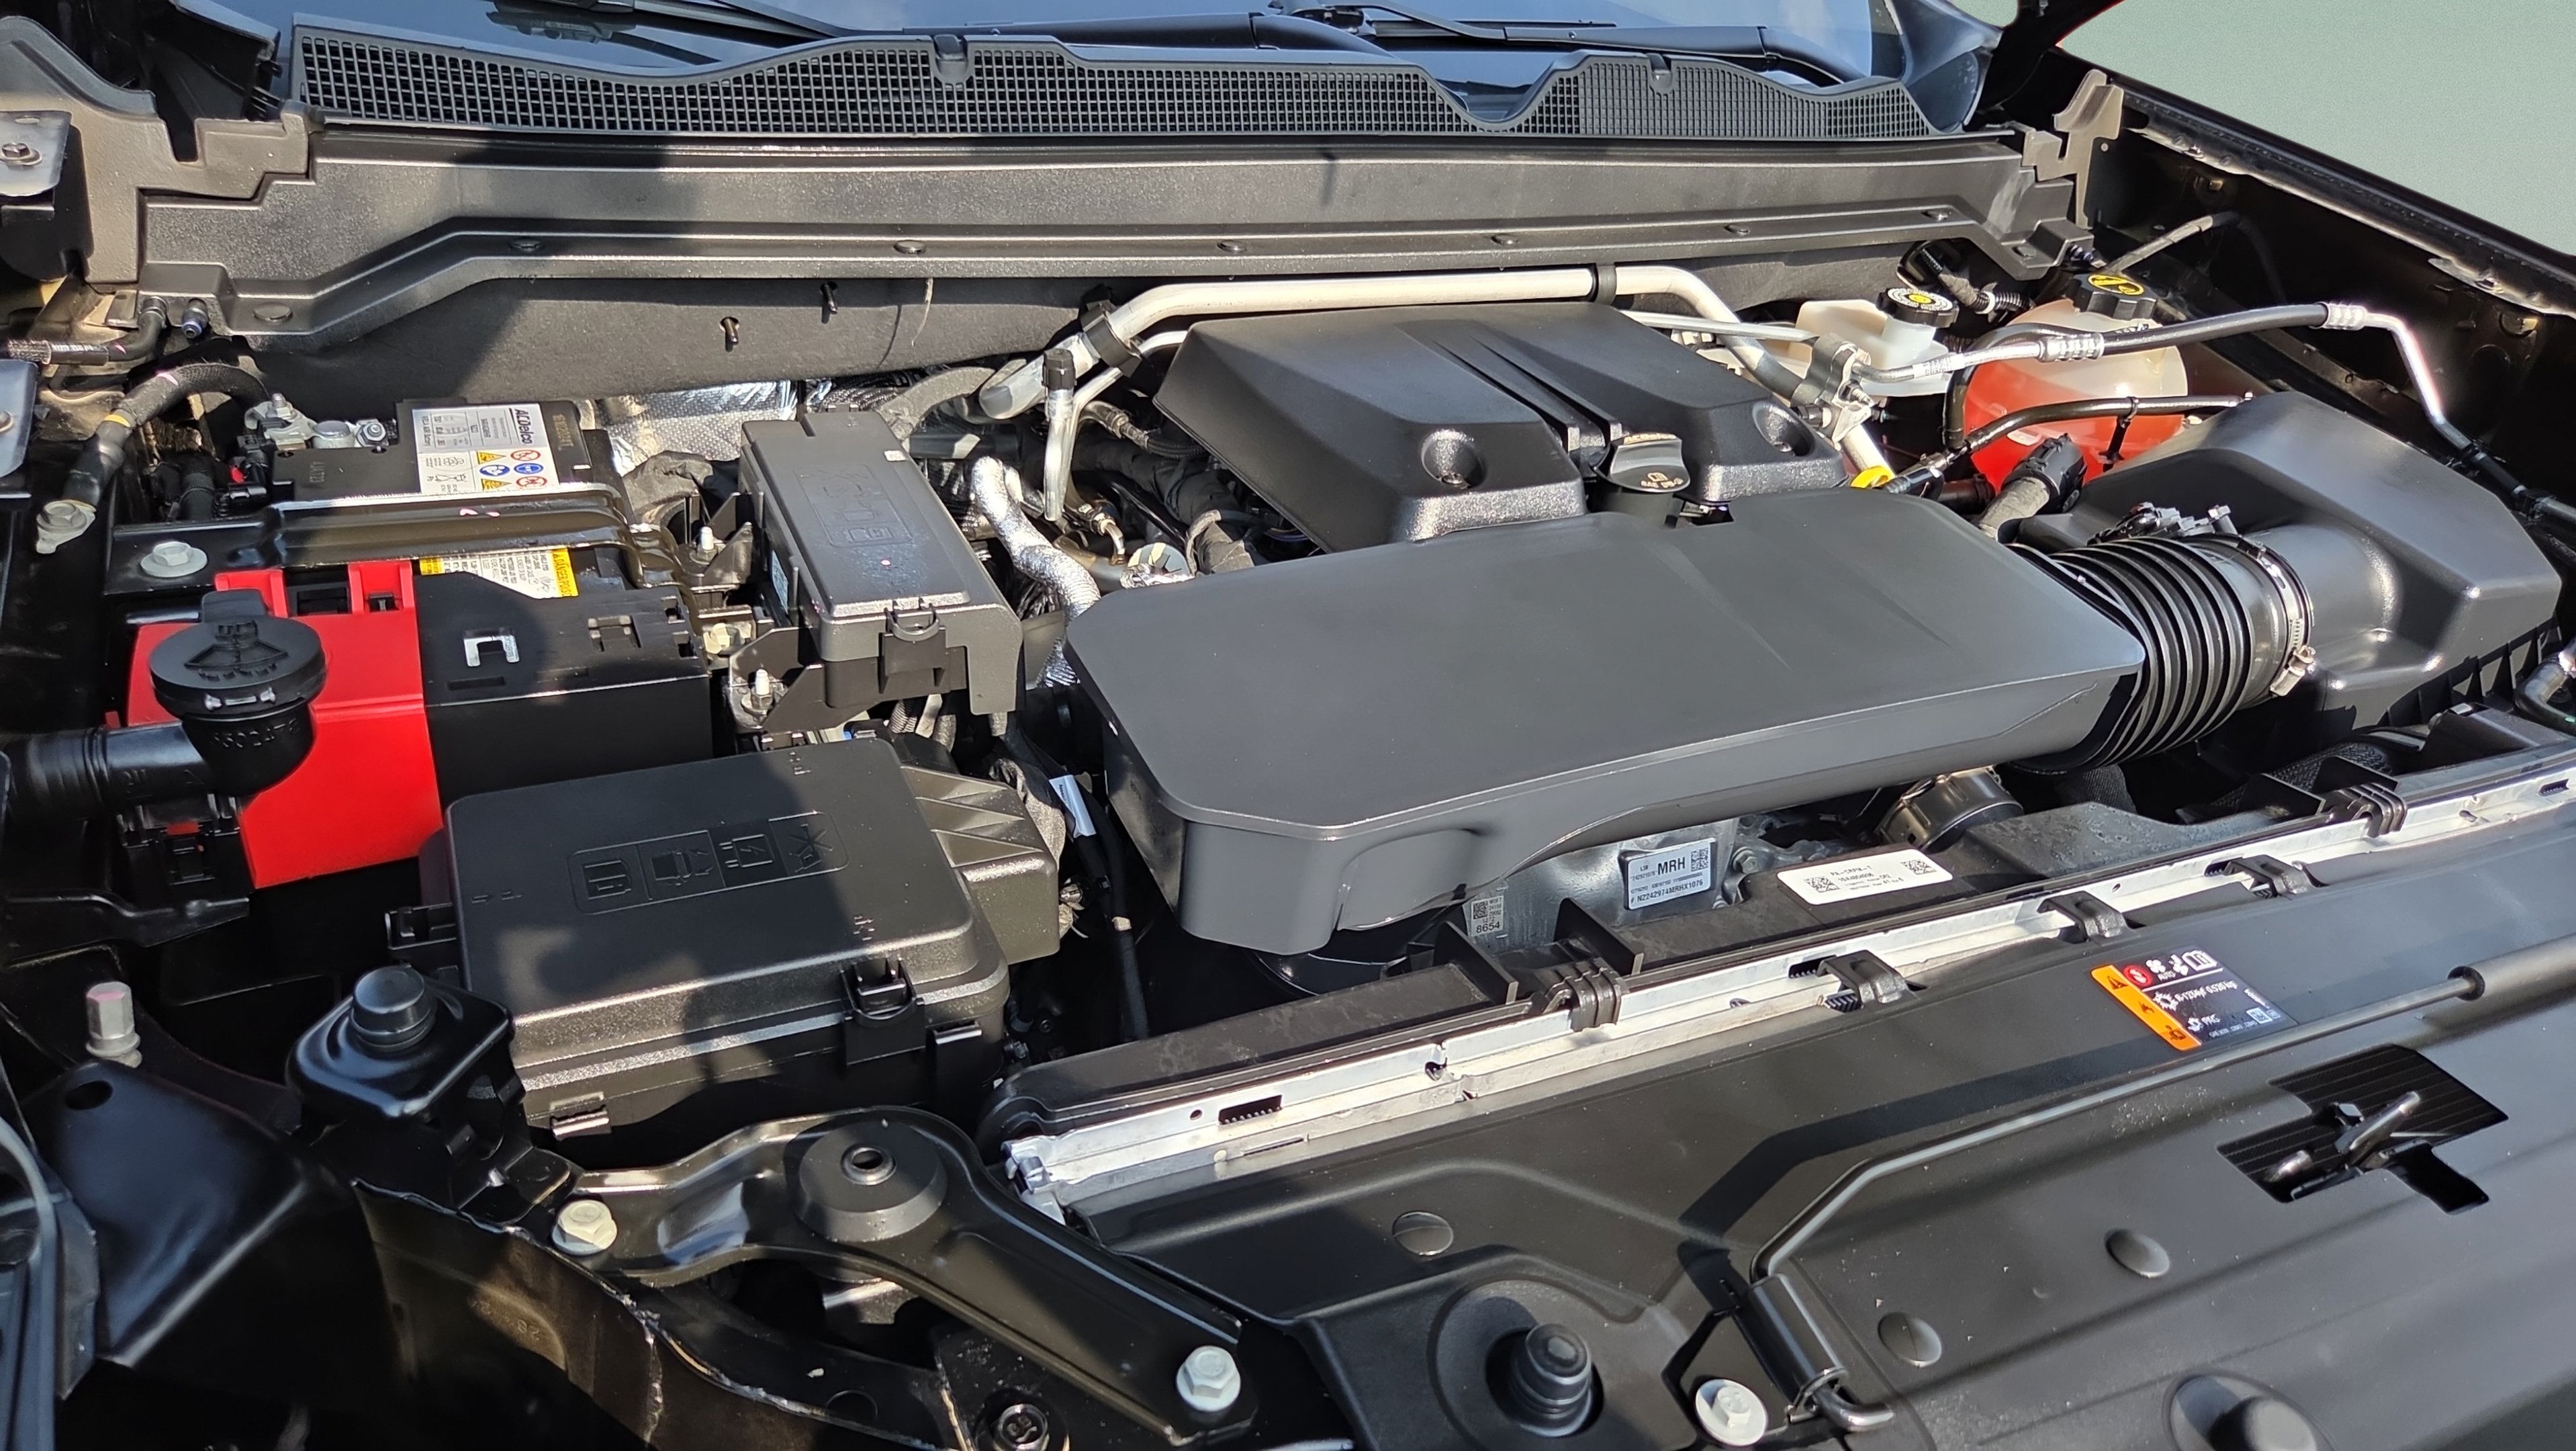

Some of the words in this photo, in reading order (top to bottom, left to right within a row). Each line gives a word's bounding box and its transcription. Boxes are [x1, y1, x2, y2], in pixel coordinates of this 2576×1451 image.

[514, 408, 534, 445] ACDelco
[1657, 856, 1685, 875] MRH
[1476, 921, 1500, 934] 8654
[2201, 1014, 2221, 1026] PAG
